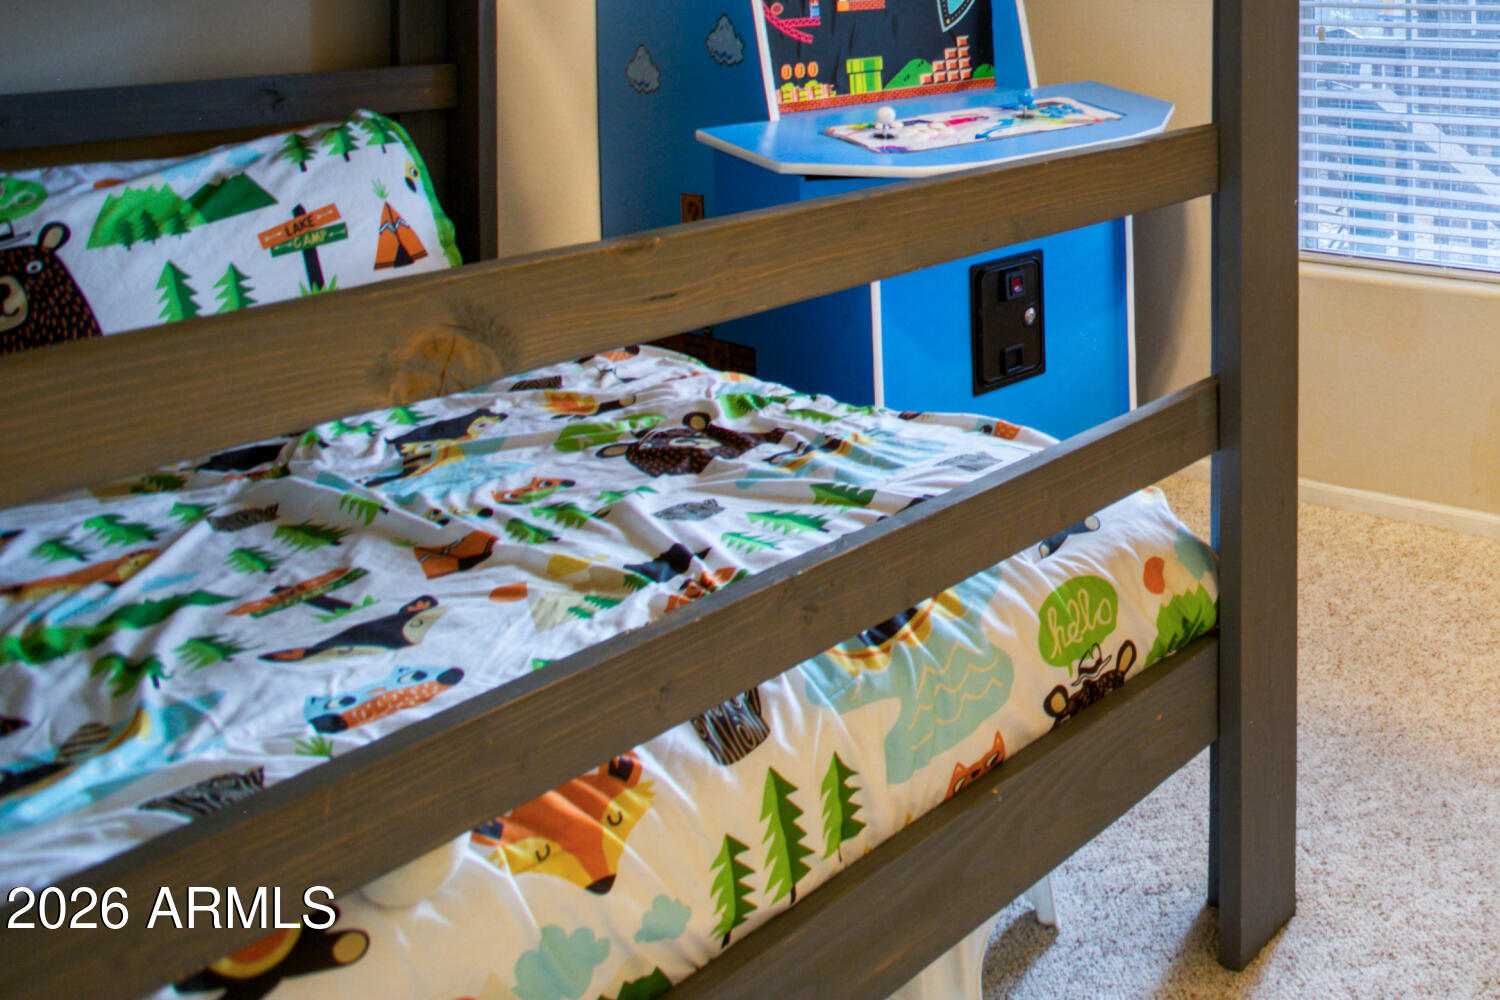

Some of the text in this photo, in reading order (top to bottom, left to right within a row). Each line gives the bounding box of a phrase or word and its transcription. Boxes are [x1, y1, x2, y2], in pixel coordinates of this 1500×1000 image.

[284, 214, 314, 237] LAKE
[292, 230, 326, 249] CAMP
[1047, 588, 1112, 659] hello
